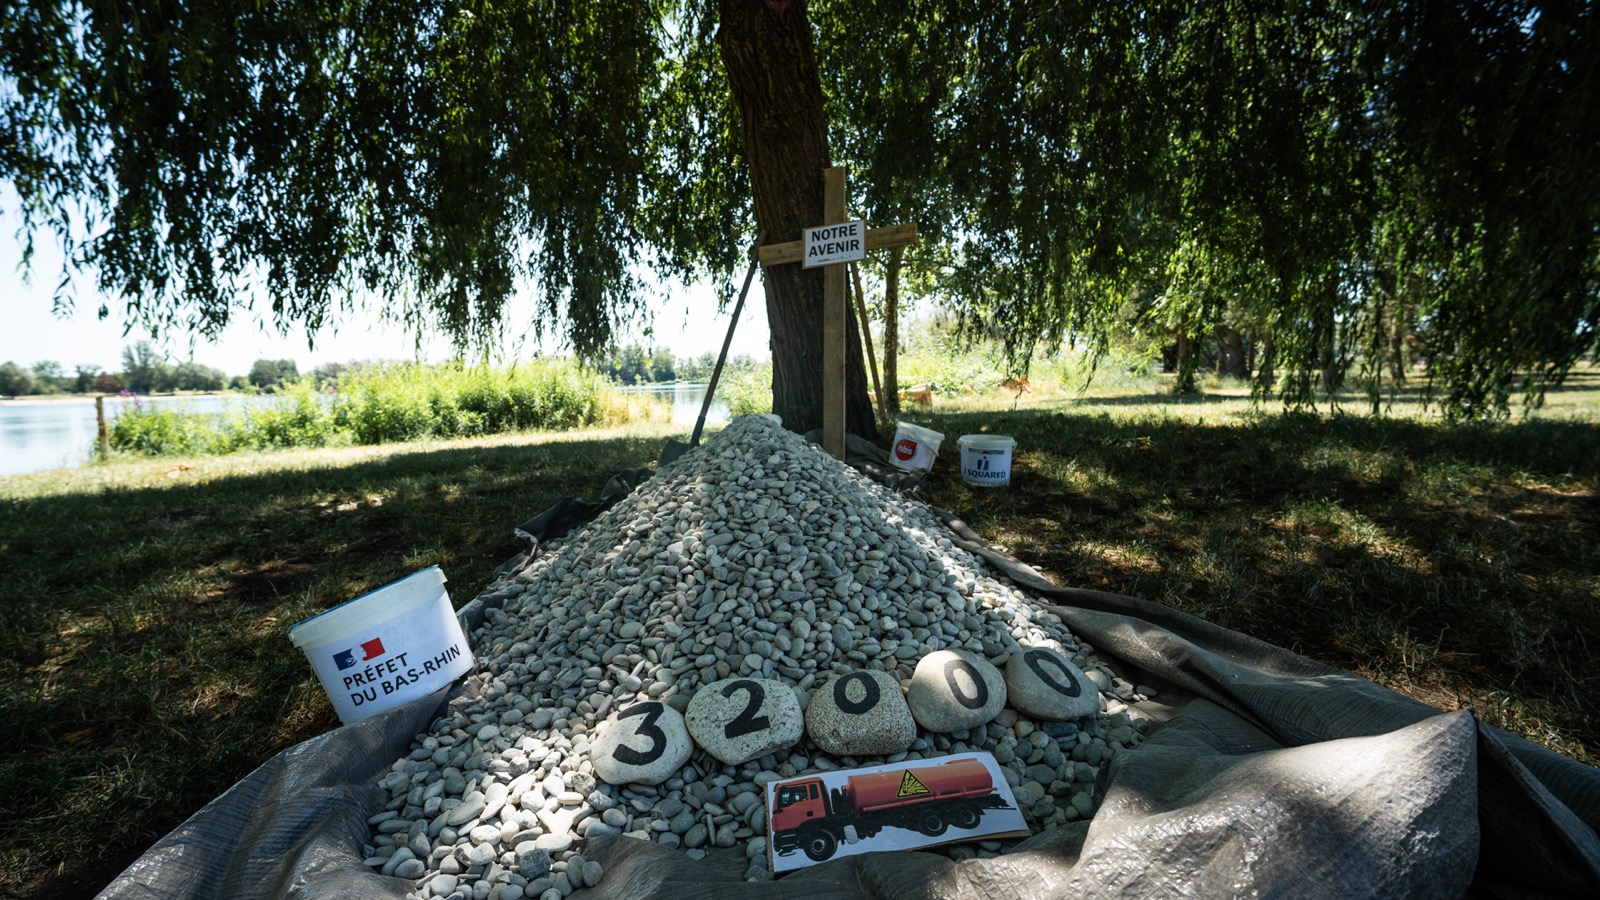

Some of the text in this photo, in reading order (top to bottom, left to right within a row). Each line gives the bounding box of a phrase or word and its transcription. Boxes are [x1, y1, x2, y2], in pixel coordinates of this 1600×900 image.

[812, 224, 857, 242] NOTRE
[809, 239, 859, 257] AVENIR
[898, 445, 912, 455] rubis
[967, 469, 1006, 479] SQUARED
[343, 652, 408, 690] PRÉFET
[350, 644, 461, 707] DU BAS-RHIN
